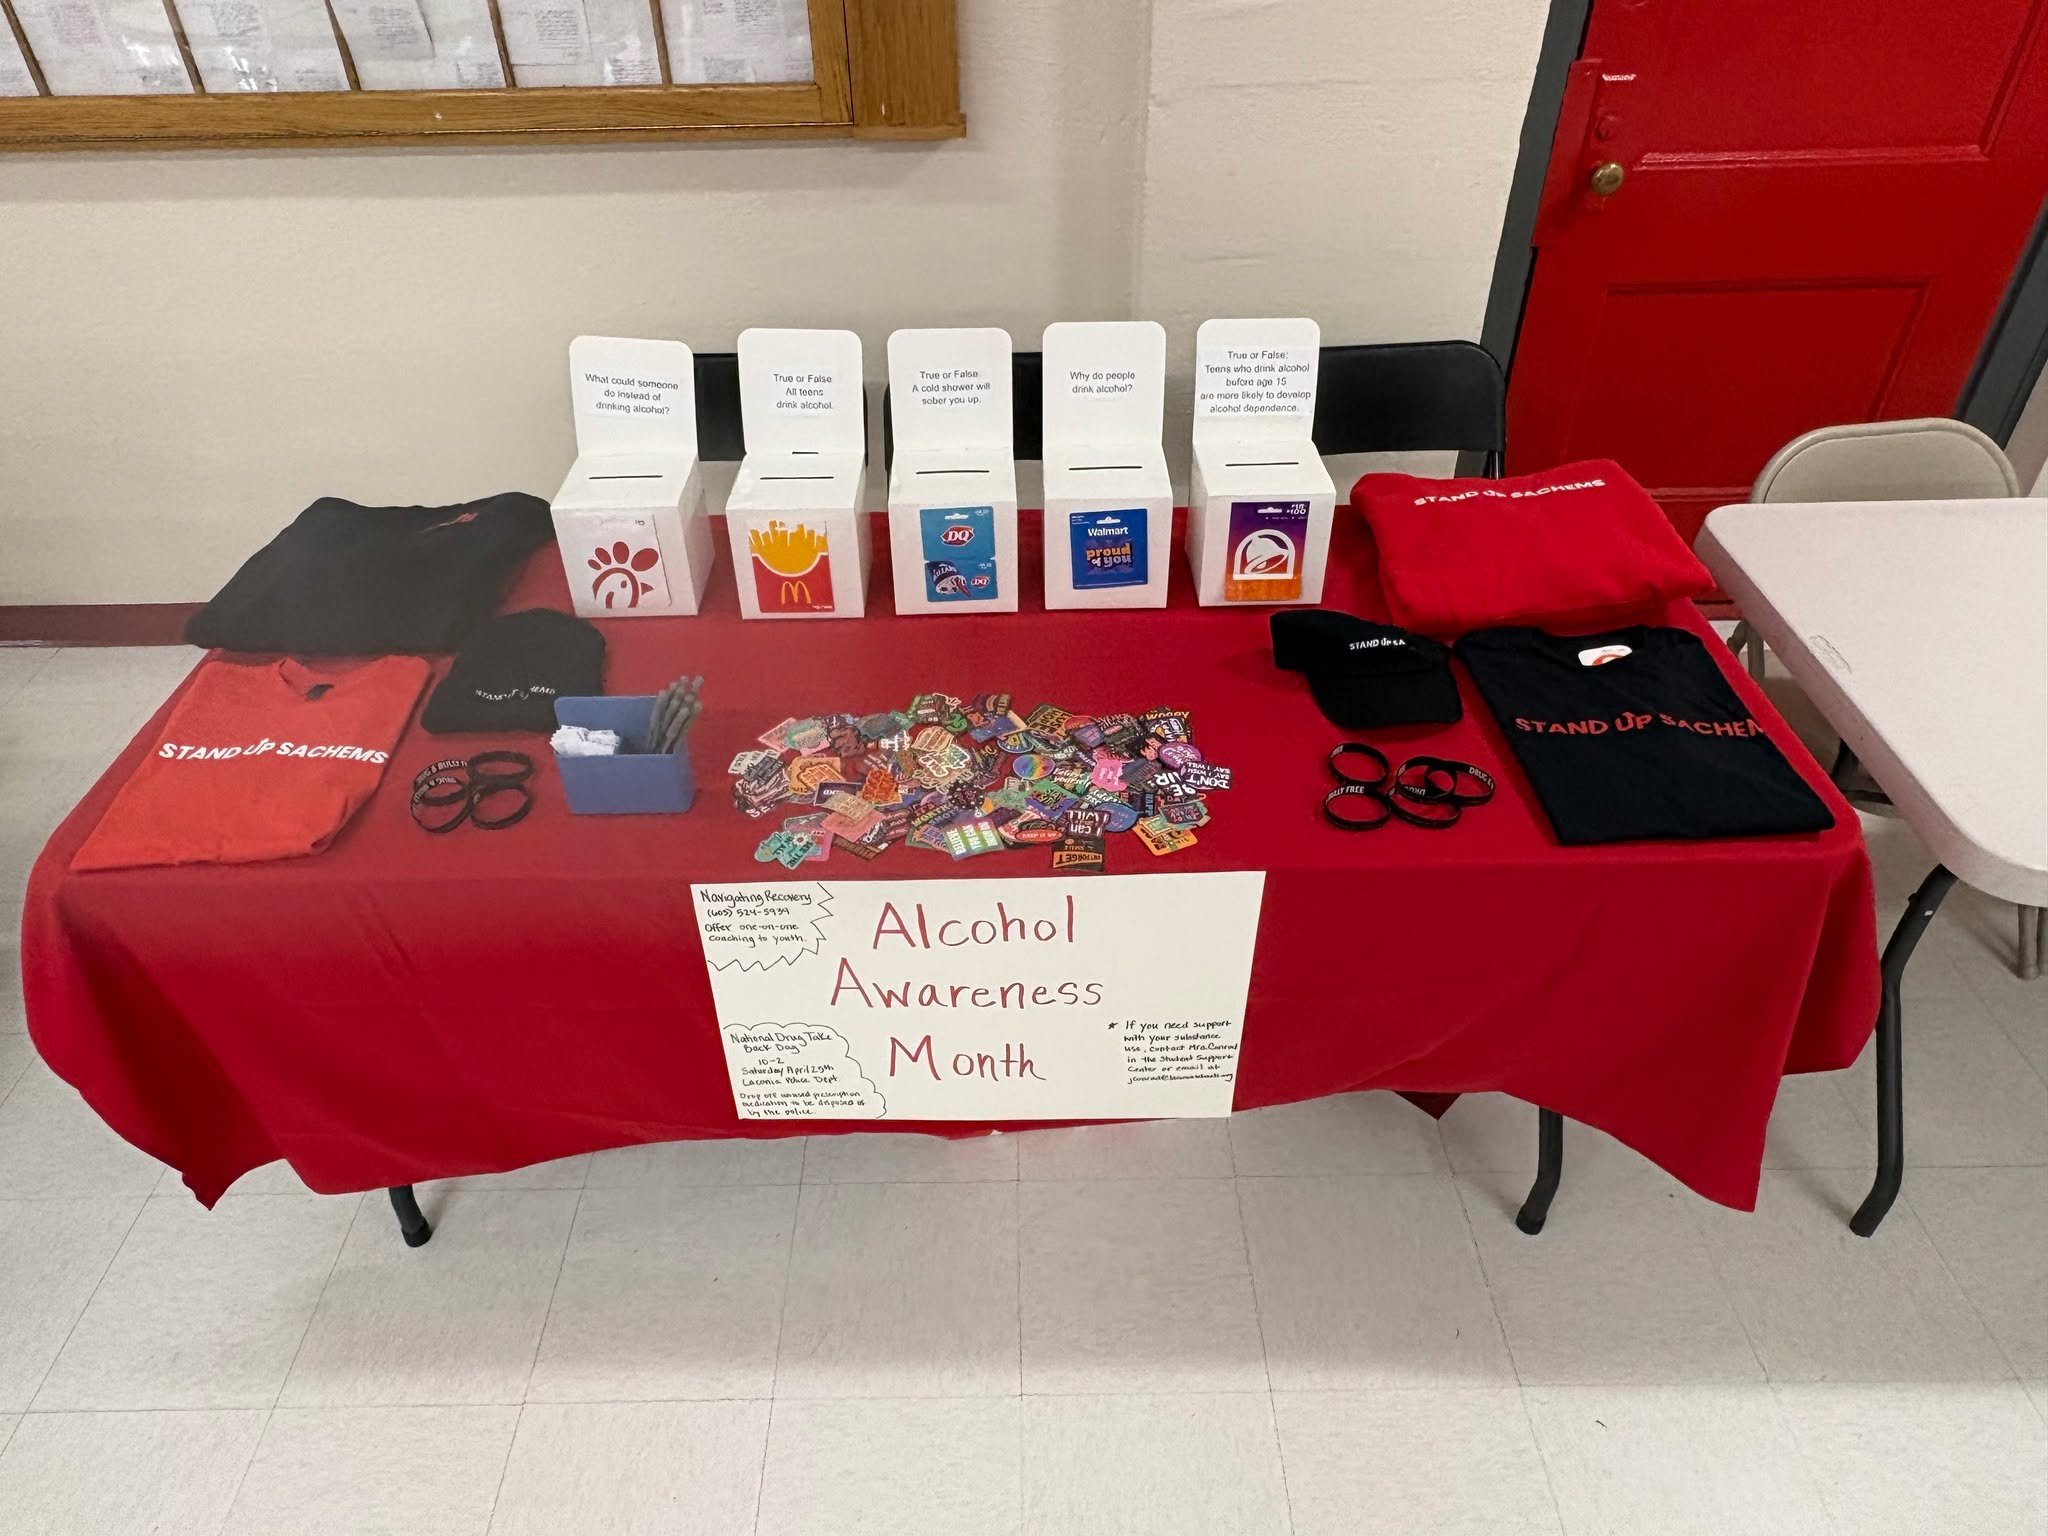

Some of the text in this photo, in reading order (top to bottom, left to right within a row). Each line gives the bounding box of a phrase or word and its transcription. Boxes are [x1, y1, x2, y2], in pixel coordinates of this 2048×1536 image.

[1228, 351, 1247, 360] True
[1250, 352, 1258, 360] or
[1205, 363, 1310, 373] Teens who drink alcohol
[774, 373, 793, 383] True
[920, 371, 940, 380] True
[1070, 371, 1136, 382] Why do people
[585, 373, 679, 390] What could someone
[1226, 377, 1287, 387] before age 15
[786, 387, 824, 397] All teens
[912, 382, 991, 393] A cold shower will
[1072, 384, 1133, 393] drink alcohol?
[604, 389, 661, 401] do instead of
[1216, 392, 1239, 400] more
[1241, 390, 1264, 401] likely
[1266, 391, 1275, 399] to
[1277, 390, 1312, 400] develop
[776, 400, 798, 409] drink
[922, 396, 946, 405] sober
[949, 396, 965, 406] you
[596, 401, 670, 415] drinking alcohol?
[1210, 404, 1241, 414] alcohol
[1414, 490, 1480, 506] STAND
[1510, 479, 1606, 499] SACHEMS
[946, 530, 970, 542] DQ
[1087, 526, 1129, 537] Walmart
[1086, 543, 1132, 561] proud
[1091, 554, 1132, 568] of you
[974, 578, 988, 586] DQ
[1349, 639, 1380, 651] STAND
[1381, 637, 1392, 647] UP
[1515, 717, 1609, 735] STAND
[1615, 711, 1653, 732] UP
[159, 738, 389, 764] STAND UP SACHEMS
[1468, 766, 1488, 782] DRUG
[1186, 774, 1230, 789] DON'T
[1345, 785, 1365, 794] FREE
[1070, 823, 1092, 834] can
[700, 888, 812, 908] Navigating Recovery
[704, 922, 800, 933] Offer one-on-one
[872, 894, 1075, 950] Alcohol
[758, 934, 768, 942] to
[830, 956, 1105, 1010] Awareness
[1125, 1020, 1232, 1034] If you need support
[730, 1031, 834, 1047] National Drug Take
[1123, 1032, 1222, 1045] with your substance
[743, 1043, 801, 1055] Back Day
[1149, 1044, 1186, 1053] contact
[758, 1057, 785, 1066] 10-2
[888, 1033, 1048, 1083] Month
[1127, 1055, 1137, 1063] in
[1141, 1055, 1157, 1064] the
[741, 1066, 783, 1076] Saturday
[786, 1064, 812, 1076] April
[1176, 1063, 1204, 1072] email
[1207, 1063, 1221, 1071] at
[742, 1077, 782, 1087] Laconia
[739, 1092, 761, 1102] Drop
[763, 1092, 778, 1100] off
[802, 1099, 815, 1107] be
[747, 1108, 760, 1118] by
[763, 1108, 781, 1116] the
